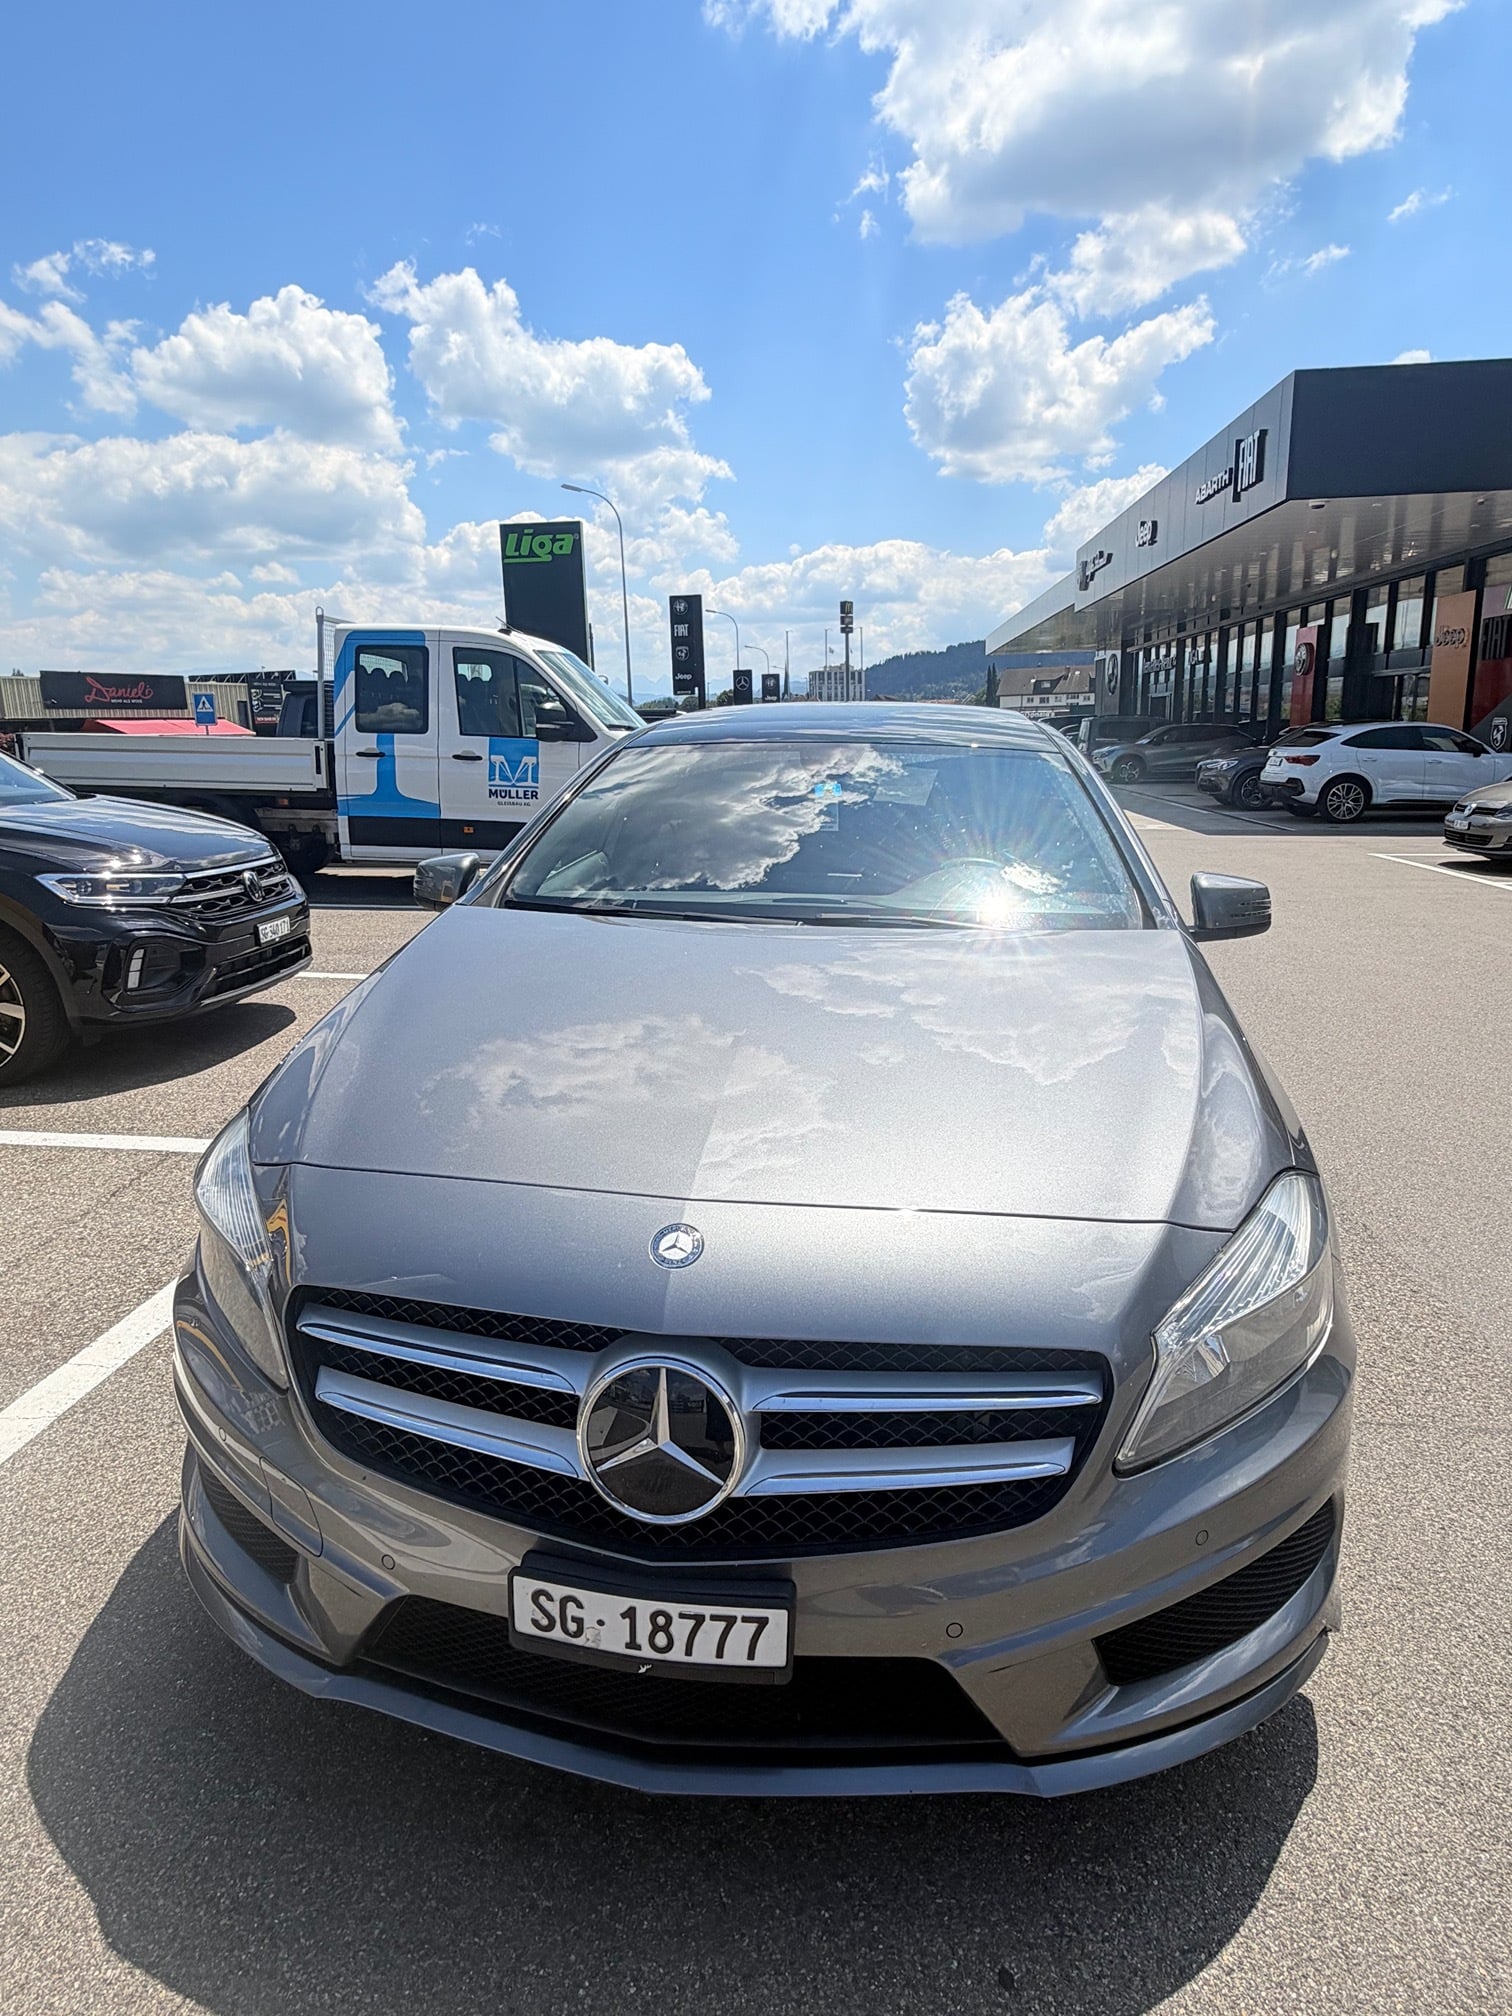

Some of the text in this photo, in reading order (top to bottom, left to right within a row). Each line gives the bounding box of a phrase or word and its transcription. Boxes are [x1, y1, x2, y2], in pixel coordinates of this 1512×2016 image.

[1237, 430, 1261, 493] FIAT
[1195, 467, 1230, 504] ABARTH
[504, 528, 574, 563] Liga
[674, 624, 689, 637] FIAT
[675, 672, 692, 680] Jeep
[488, 788, 539, 800] MÜLLER
[530, 1588, 770, 1662] SG 18777
